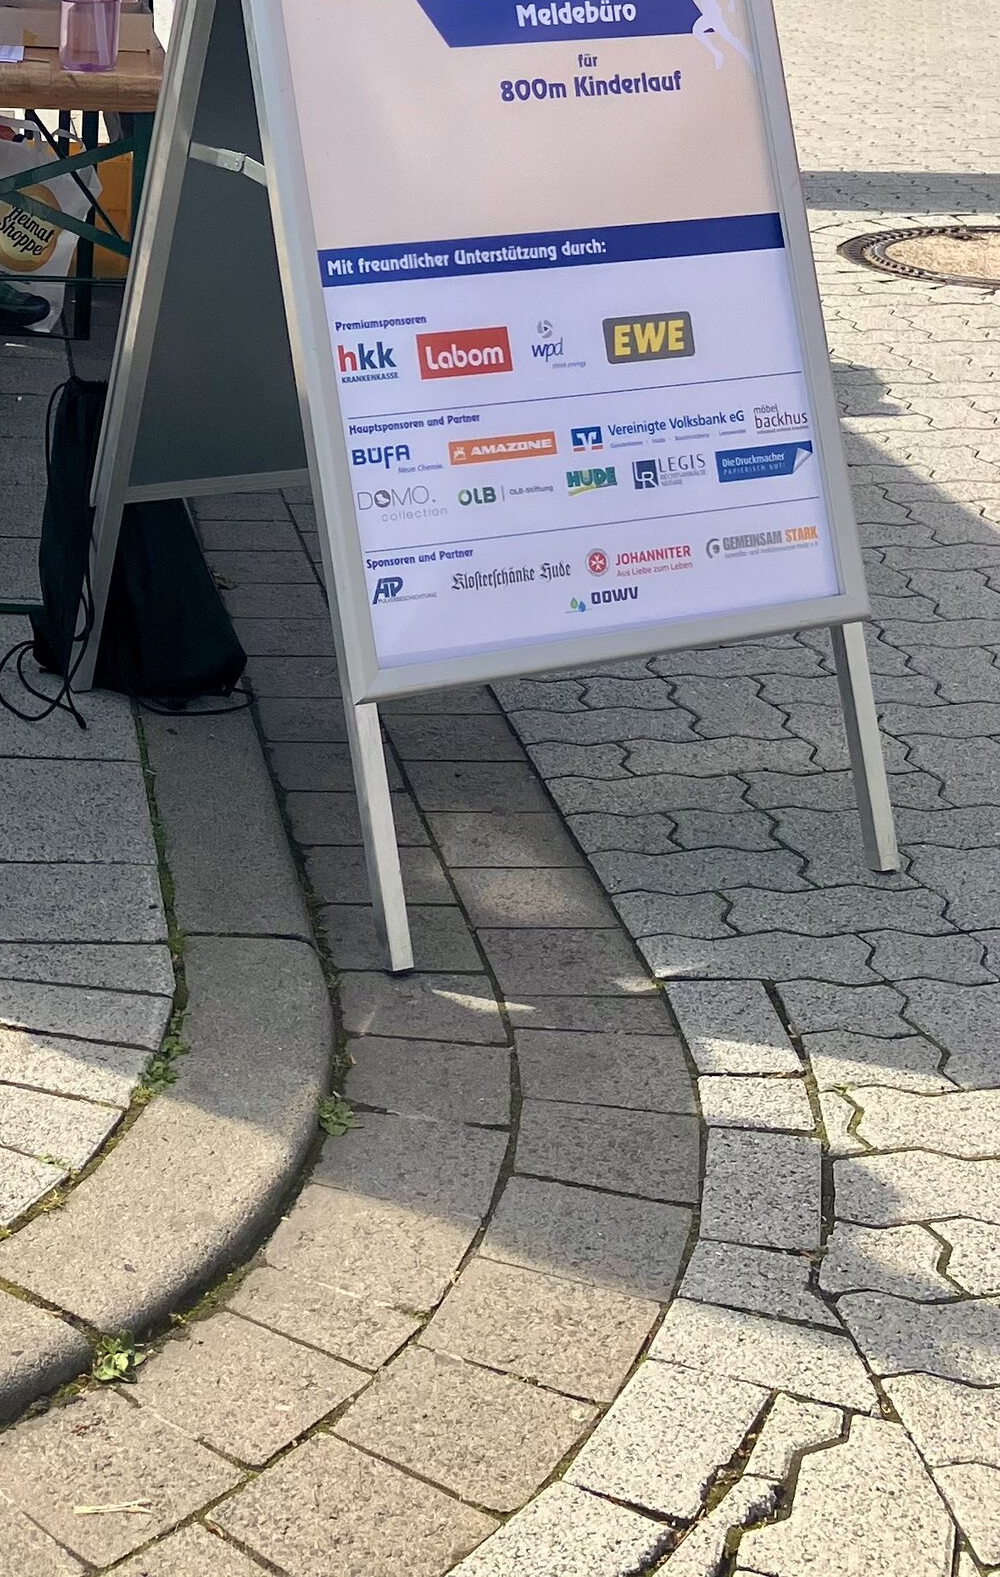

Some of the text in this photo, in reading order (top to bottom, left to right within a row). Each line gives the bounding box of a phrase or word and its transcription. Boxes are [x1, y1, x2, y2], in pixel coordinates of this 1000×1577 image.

[516, 0, 636, 27] Meldebüro
[578, 53, 598, 68] für
[500, 71, 681, 102] 800m Kinderlauf
[328, 239, 606, 276] Mit freundlicher Unterstützung durch:
[335, 315, 427, 332] Premiumsponsoren
[613, 319, 686, 356] EWE
[338, 341, 397, 372] hkk
[425, 343, 504, 370] Labom
[531, 337, 563, 362] wpd
[342, 372, 399, 383] KRANKENKASSE
[753, 403, 778, 414] möbel
[349, 414, 480, 435] Hauptsponsoren und Partner
[608, 410, 745, 435] Vereinigte Volksbank eG
[755, 411, 808, 429] backhus
[352, 444, 410, 469] BÜFA
[470, 439, 552, 456] AMAZONE
[658, 453, 706, 473] LEGIS
[566, 466, 617, 488] HUDE
[458, 486, 497, 506] OLB
[381, 506, 448, 522] collection
[722, 530, 783, 551] GEMEINSAM
[785, 525, 818, 542] STARK
[366, 548, 474, 571] Sponsoren und Partner
[616, 545, 691, 566] JOHANNITER
[617, 561, 693, 577] Aus Liebe zum Leben
[591, 586, 638, 605] OOWV
